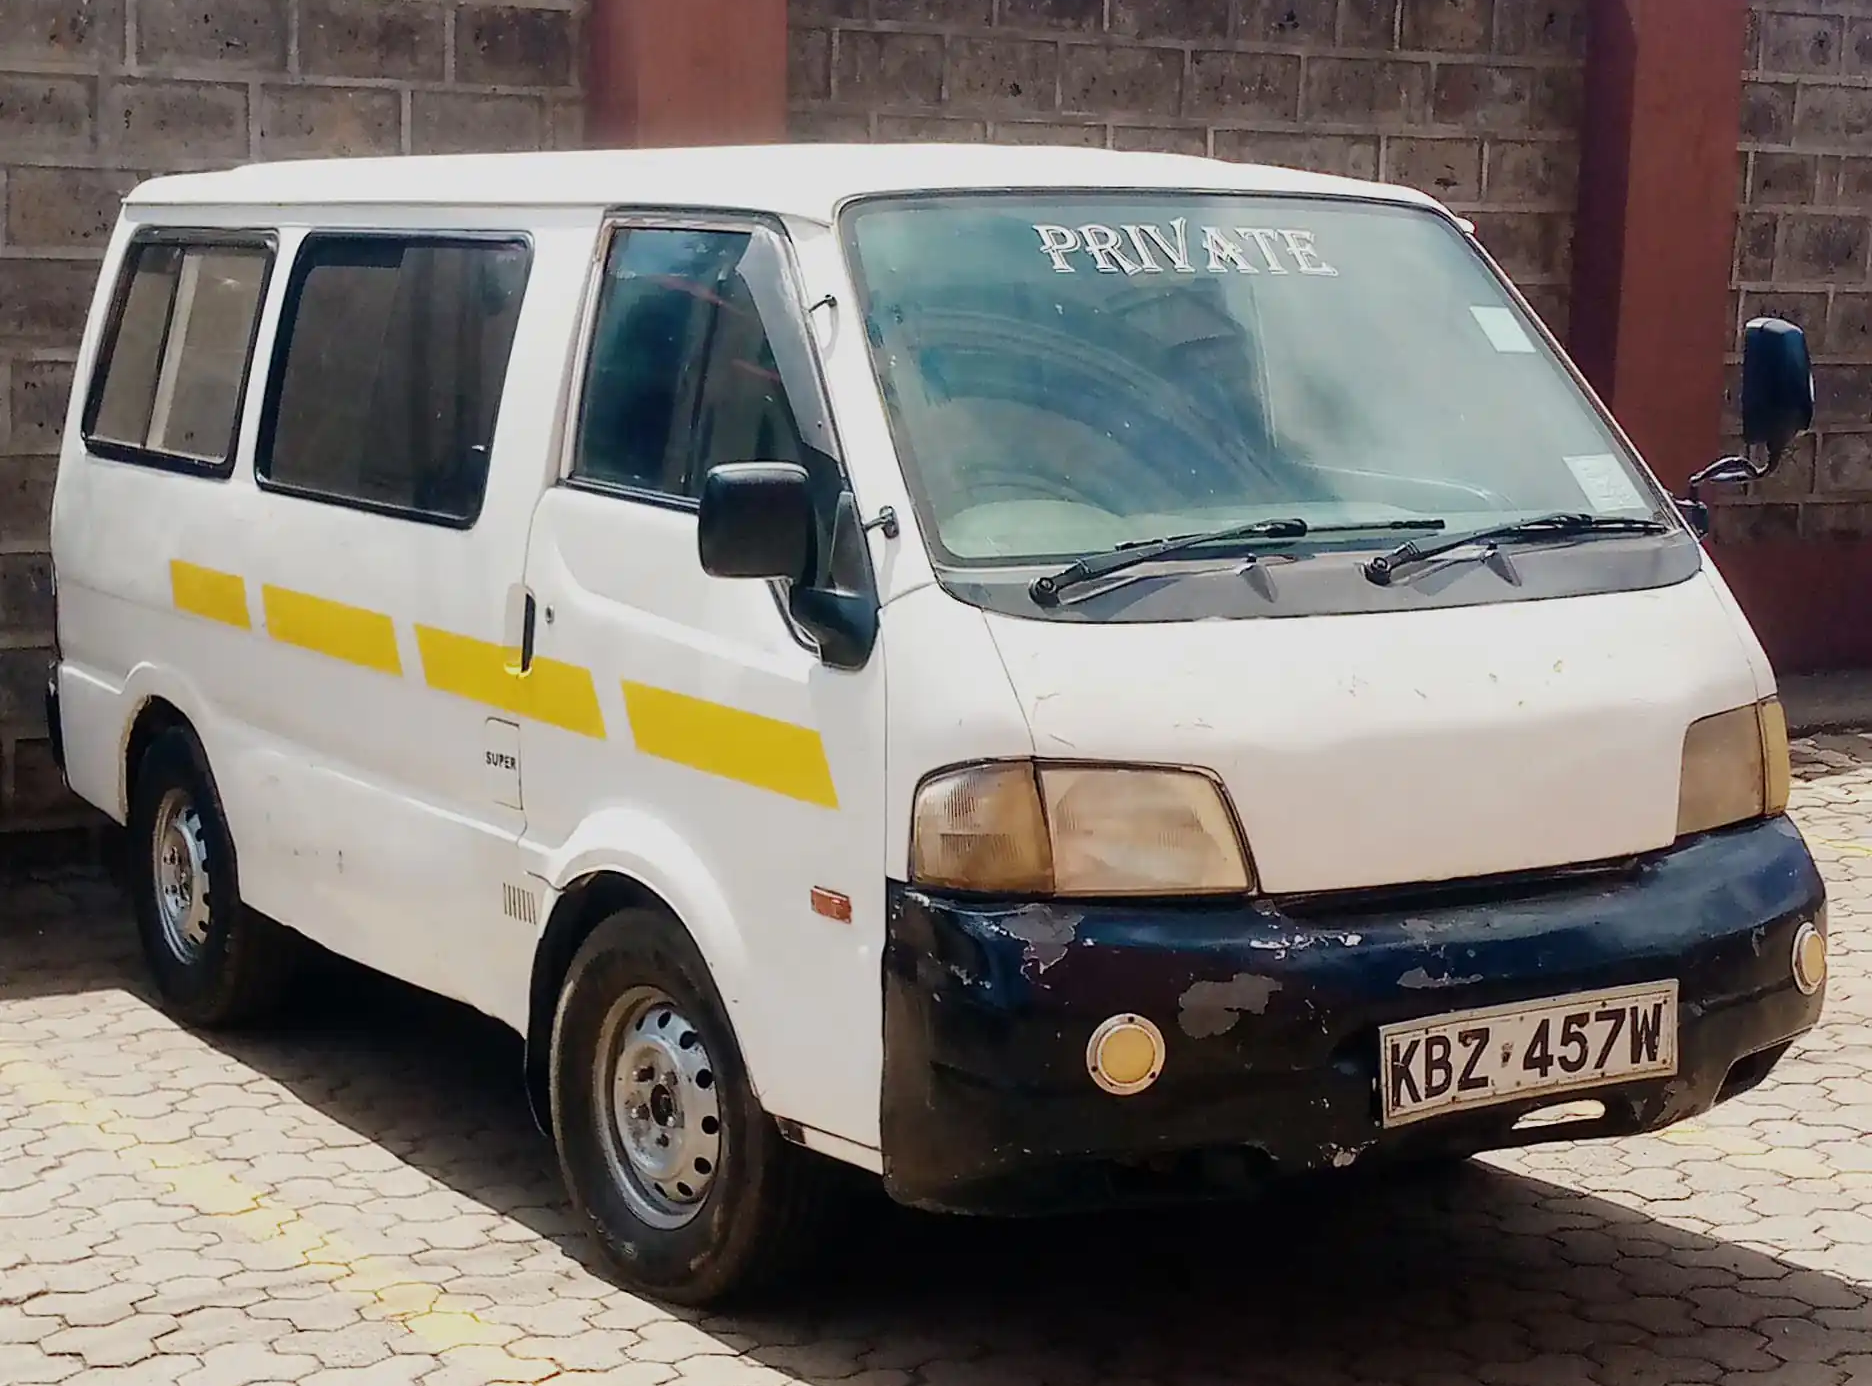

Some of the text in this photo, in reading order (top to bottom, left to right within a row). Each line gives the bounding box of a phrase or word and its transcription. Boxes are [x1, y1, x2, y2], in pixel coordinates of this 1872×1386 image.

[1032, 216, 1340, 277] PRIVATE
[486, 751, 517, 770] SUPER
[1390, 1003, 1663, 1111] KBZ 457W
